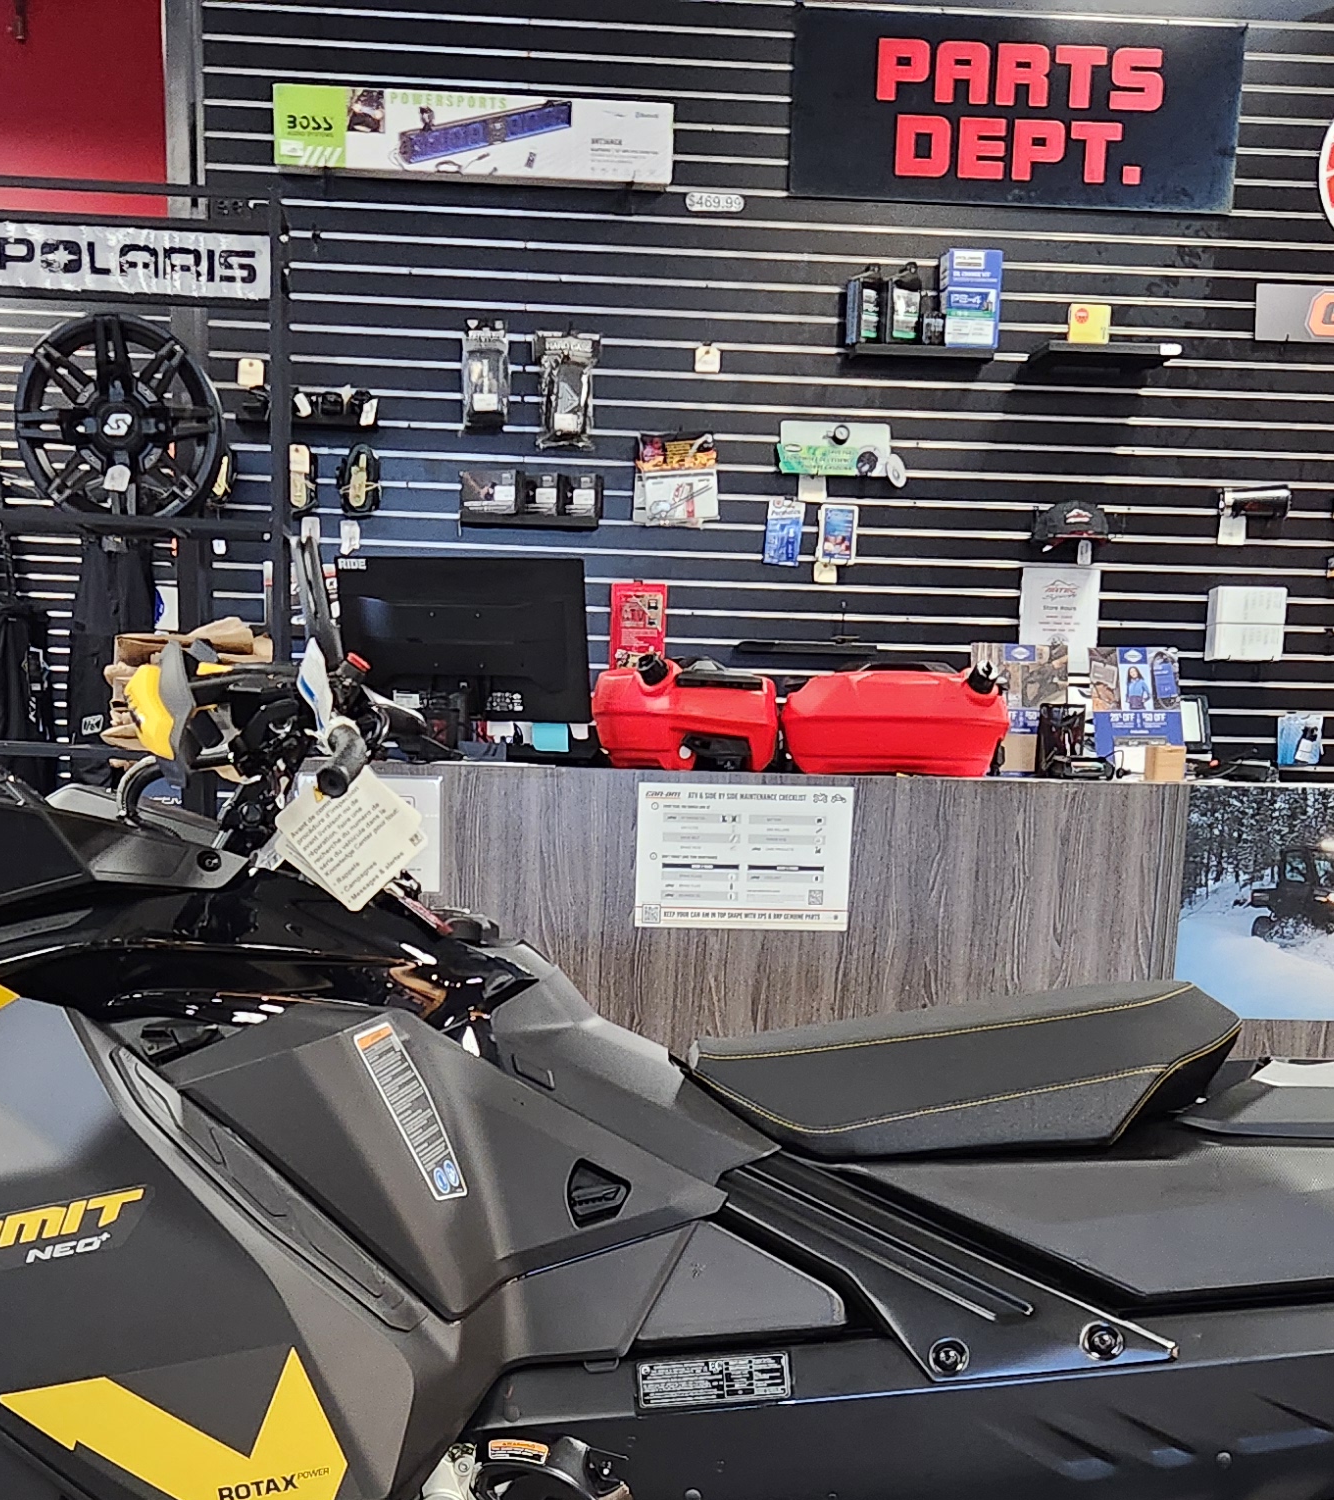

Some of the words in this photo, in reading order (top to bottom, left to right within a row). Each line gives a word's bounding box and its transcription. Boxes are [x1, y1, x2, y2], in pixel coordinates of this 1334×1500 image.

[875, 37, 1165, 112] PARTS
[390, 92, 508, 109] POWERSPORTS
[894, 114, 1142, 186] DEPT.
[688, 194, 742, 209] $469.99
[337, 558, 367, 570] RIDE
[297, 1467, 330, 1480] POWER
